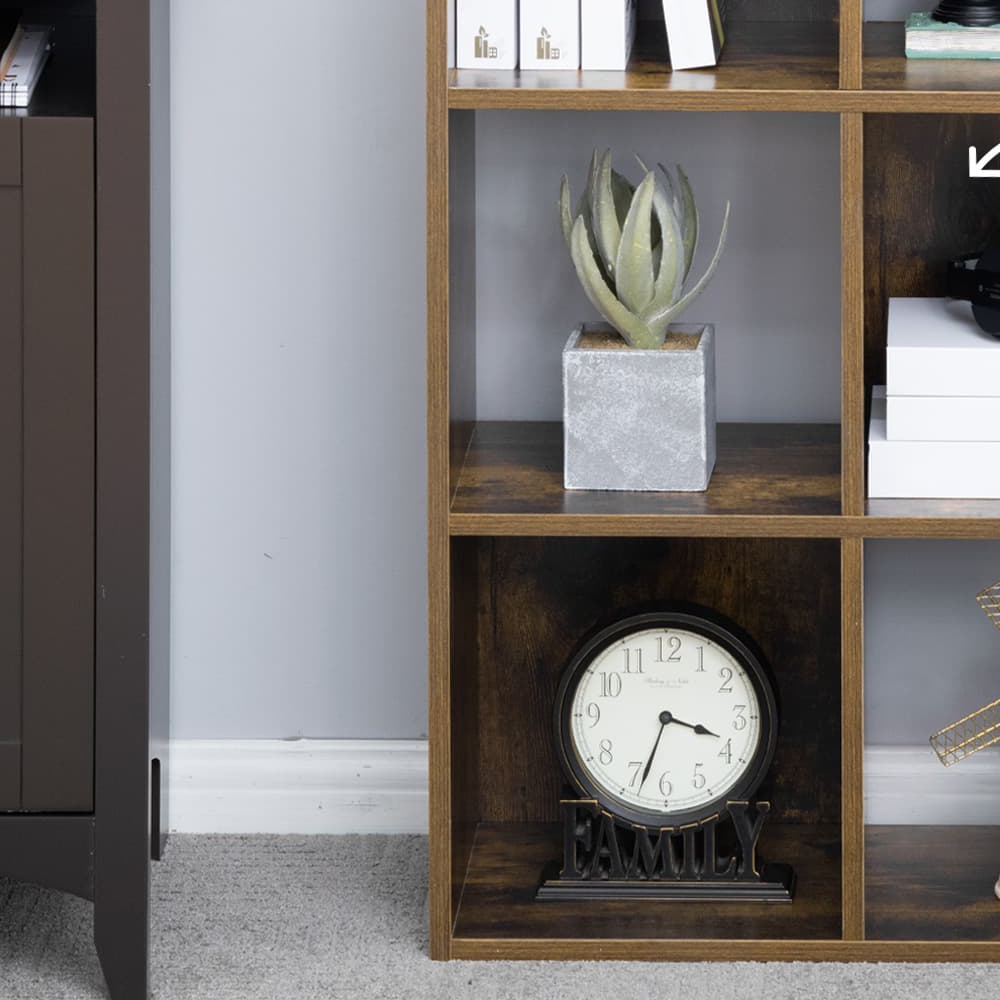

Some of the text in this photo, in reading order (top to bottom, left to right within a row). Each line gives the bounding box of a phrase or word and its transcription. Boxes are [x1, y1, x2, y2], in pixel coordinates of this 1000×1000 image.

[622, 647, 645, 674] 11
[655, 636, 682, 663] 12
[695, 646, 707, 672] 1
[599, 671, 622, 697] 10
[718, 667, 733, 693] 2
[587, 702, 601, 729] 9
[732, 704, 747, 731] 3
[599, 738, 614, 766] 8
[717, 738, 733, 764] 4
[627, 761, 643, 788] 7
[659, 770, 672, 797] 6
[693, 762, 706, 789] 5
[559, 799, 771, 881] FAMILY
